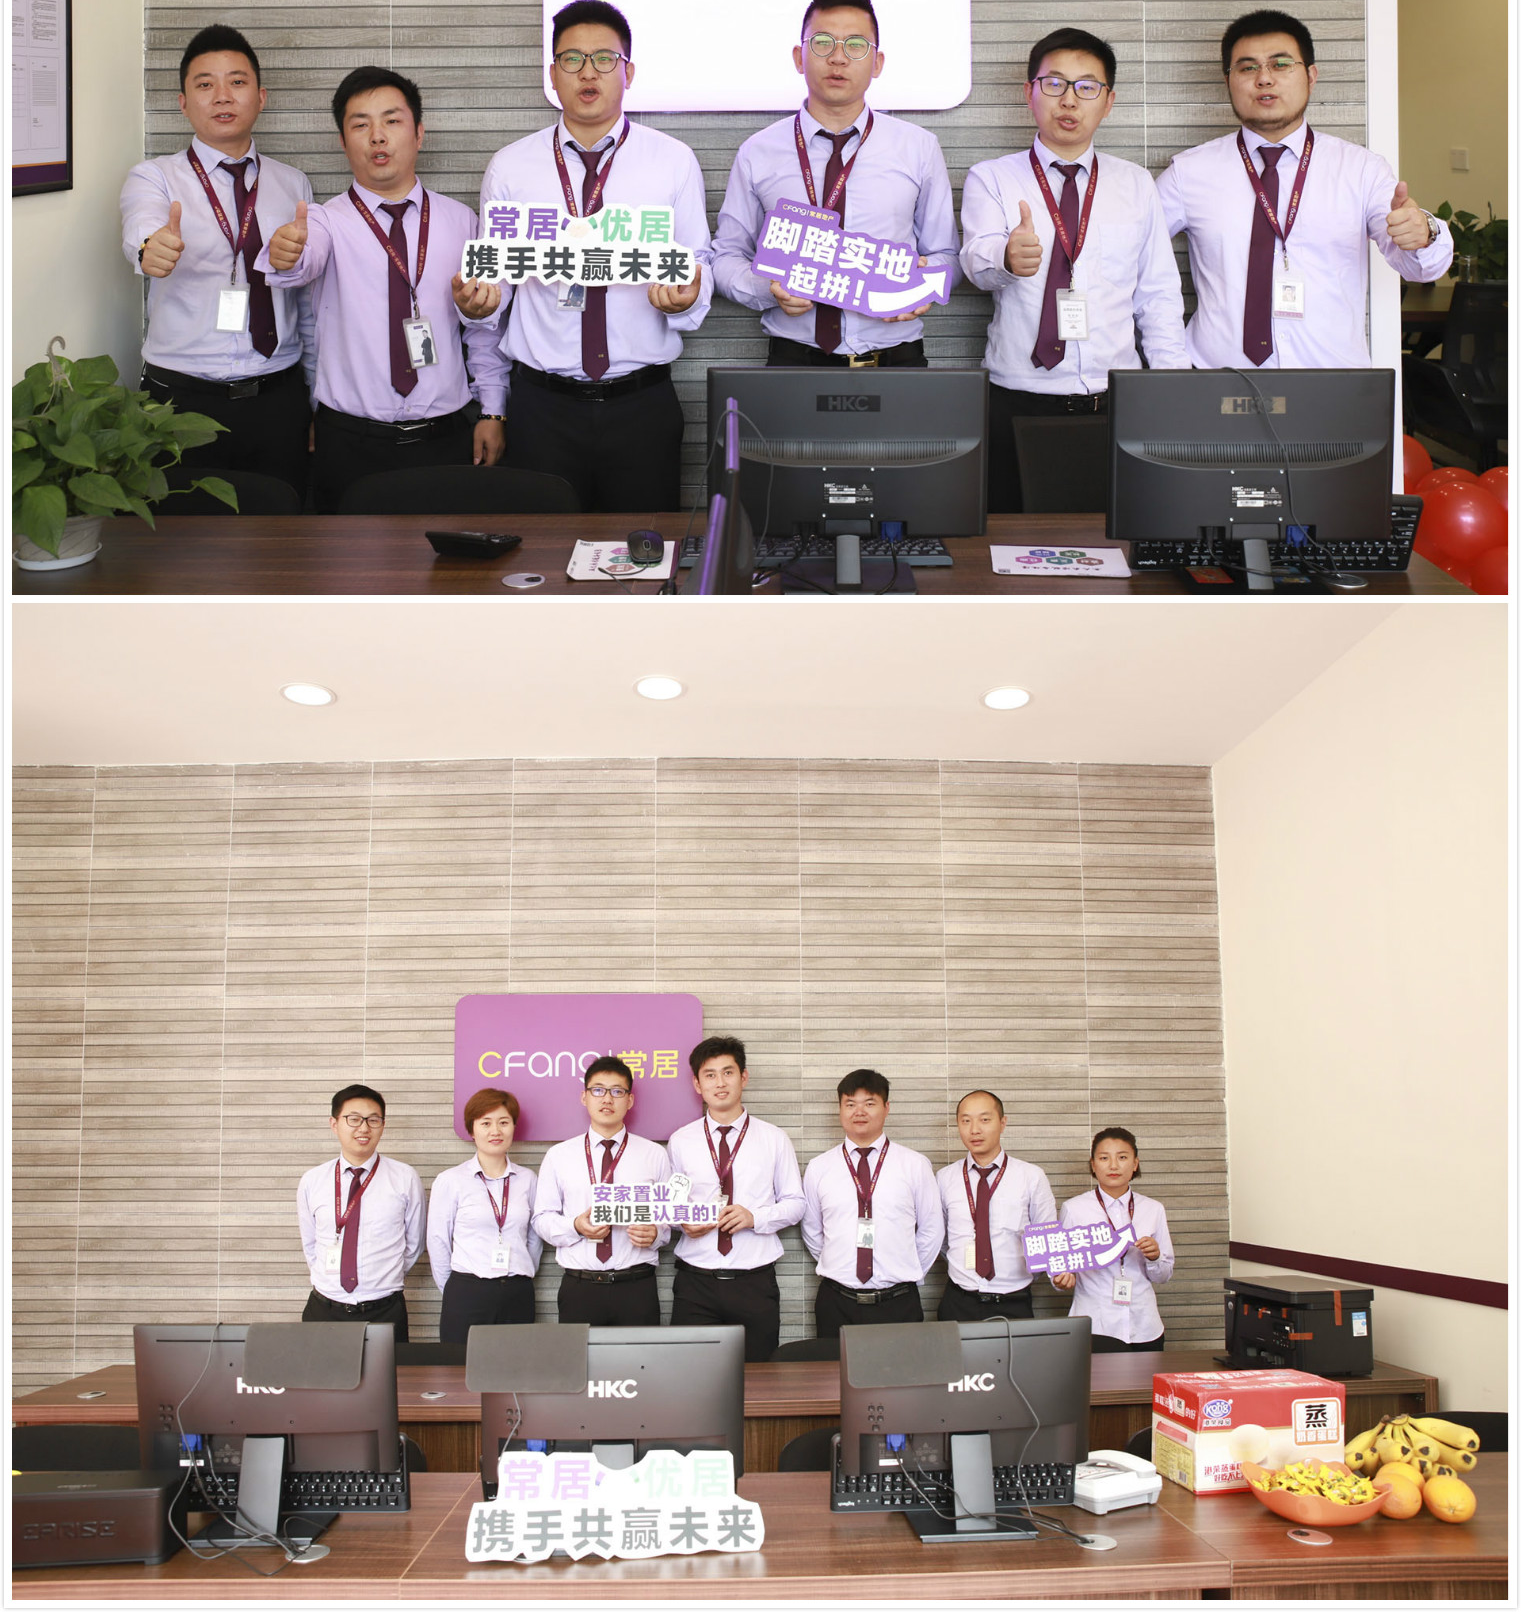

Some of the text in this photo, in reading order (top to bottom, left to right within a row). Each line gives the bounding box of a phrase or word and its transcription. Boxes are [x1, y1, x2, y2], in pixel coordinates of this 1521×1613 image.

[488, 206, 672, 243] 常居 优居
[466, 245, 690, 283] 携手共赢未来
[764, 215, 914, 283] 脚踏实地
[757, 261, 865, 307] 一起拼！
[827, 395, 869, 411] HKC
[617, 1049, 679, 1079] 常居
[594, 1185, 671, 1203] 安家置业
[1024, 1224, 1113, 1257] 脚踏实地
[236, 1378, 286, 1396] HKC
[587, 1380, 638, 1399] HKC
[947, 1372, 996, 1393] HKC
[1304, 1404, 1328, 1429] 蒸
[502, 1458, 730, 1501] 常居 优居
[471, 1505, 757, 1552] 携手共赢未来
